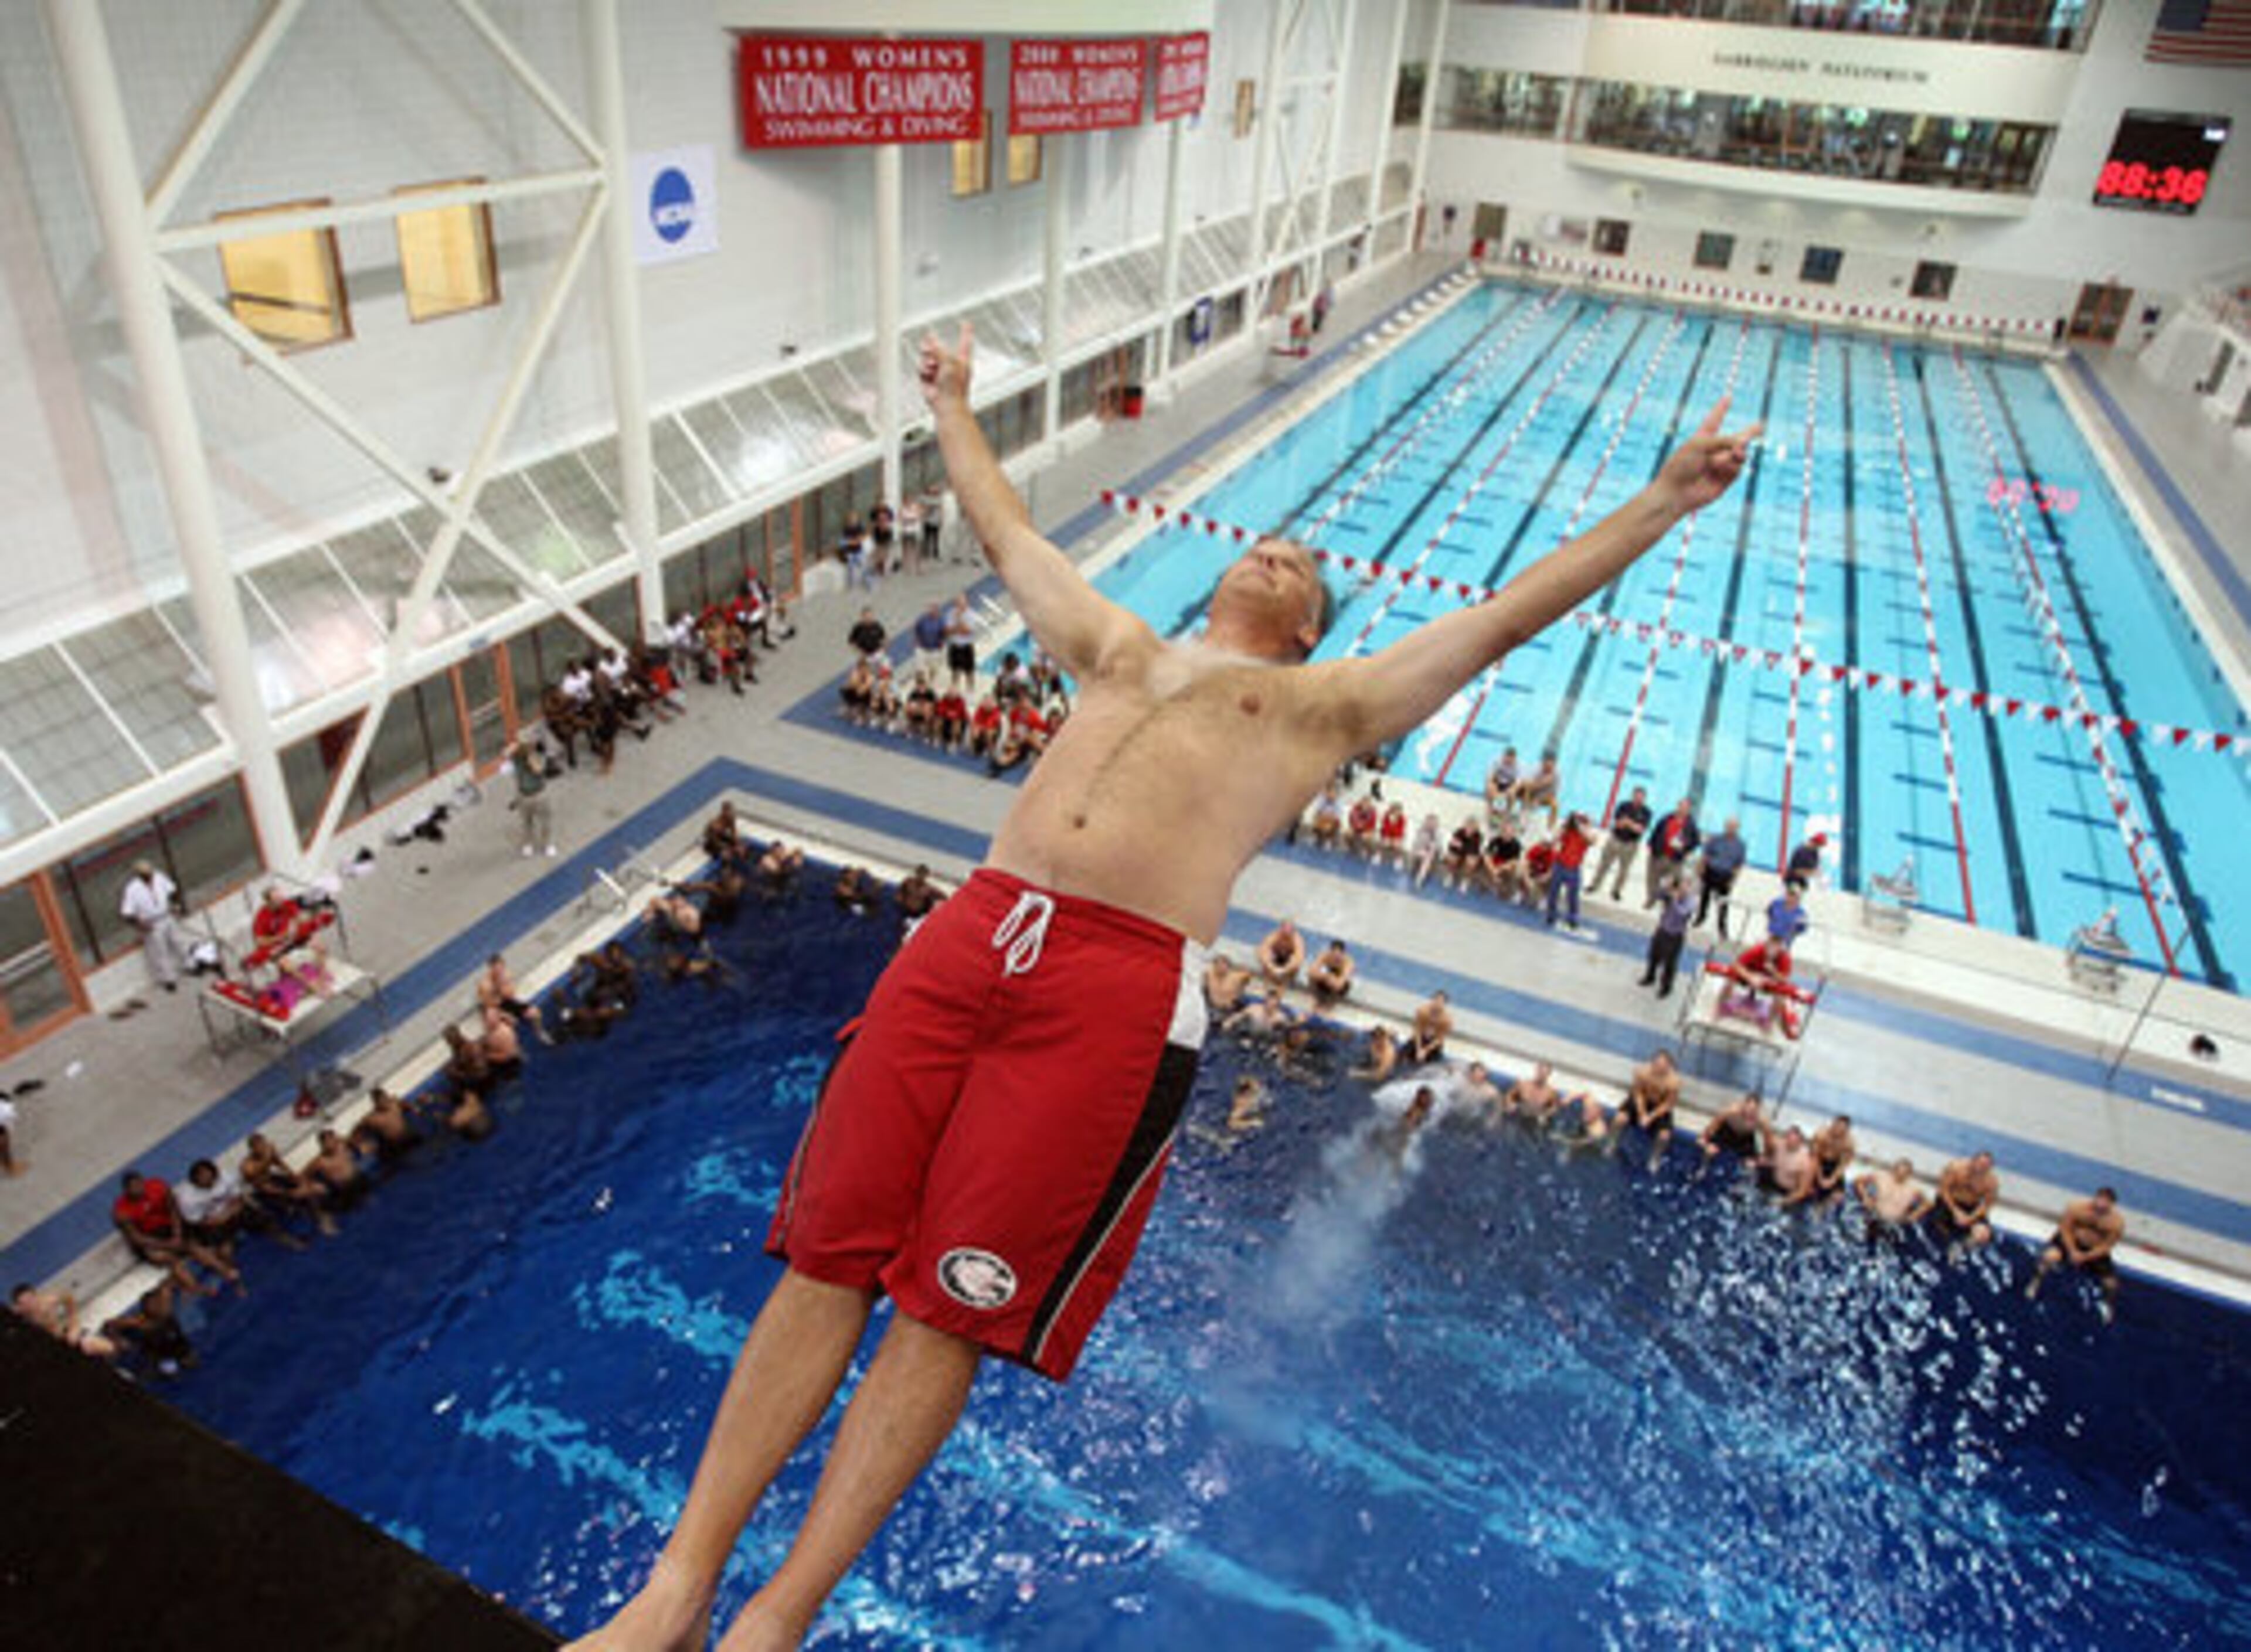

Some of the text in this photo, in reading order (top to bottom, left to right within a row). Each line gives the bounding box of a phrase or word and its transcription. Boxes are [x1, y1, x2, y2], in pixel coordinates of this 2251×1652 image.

[763, 46, 827, 68] 1999
[754, 70, 974, 114] NATIONAL CHAMPIONS
[764, 116, 970, 141] SWIMMING & DIVING
